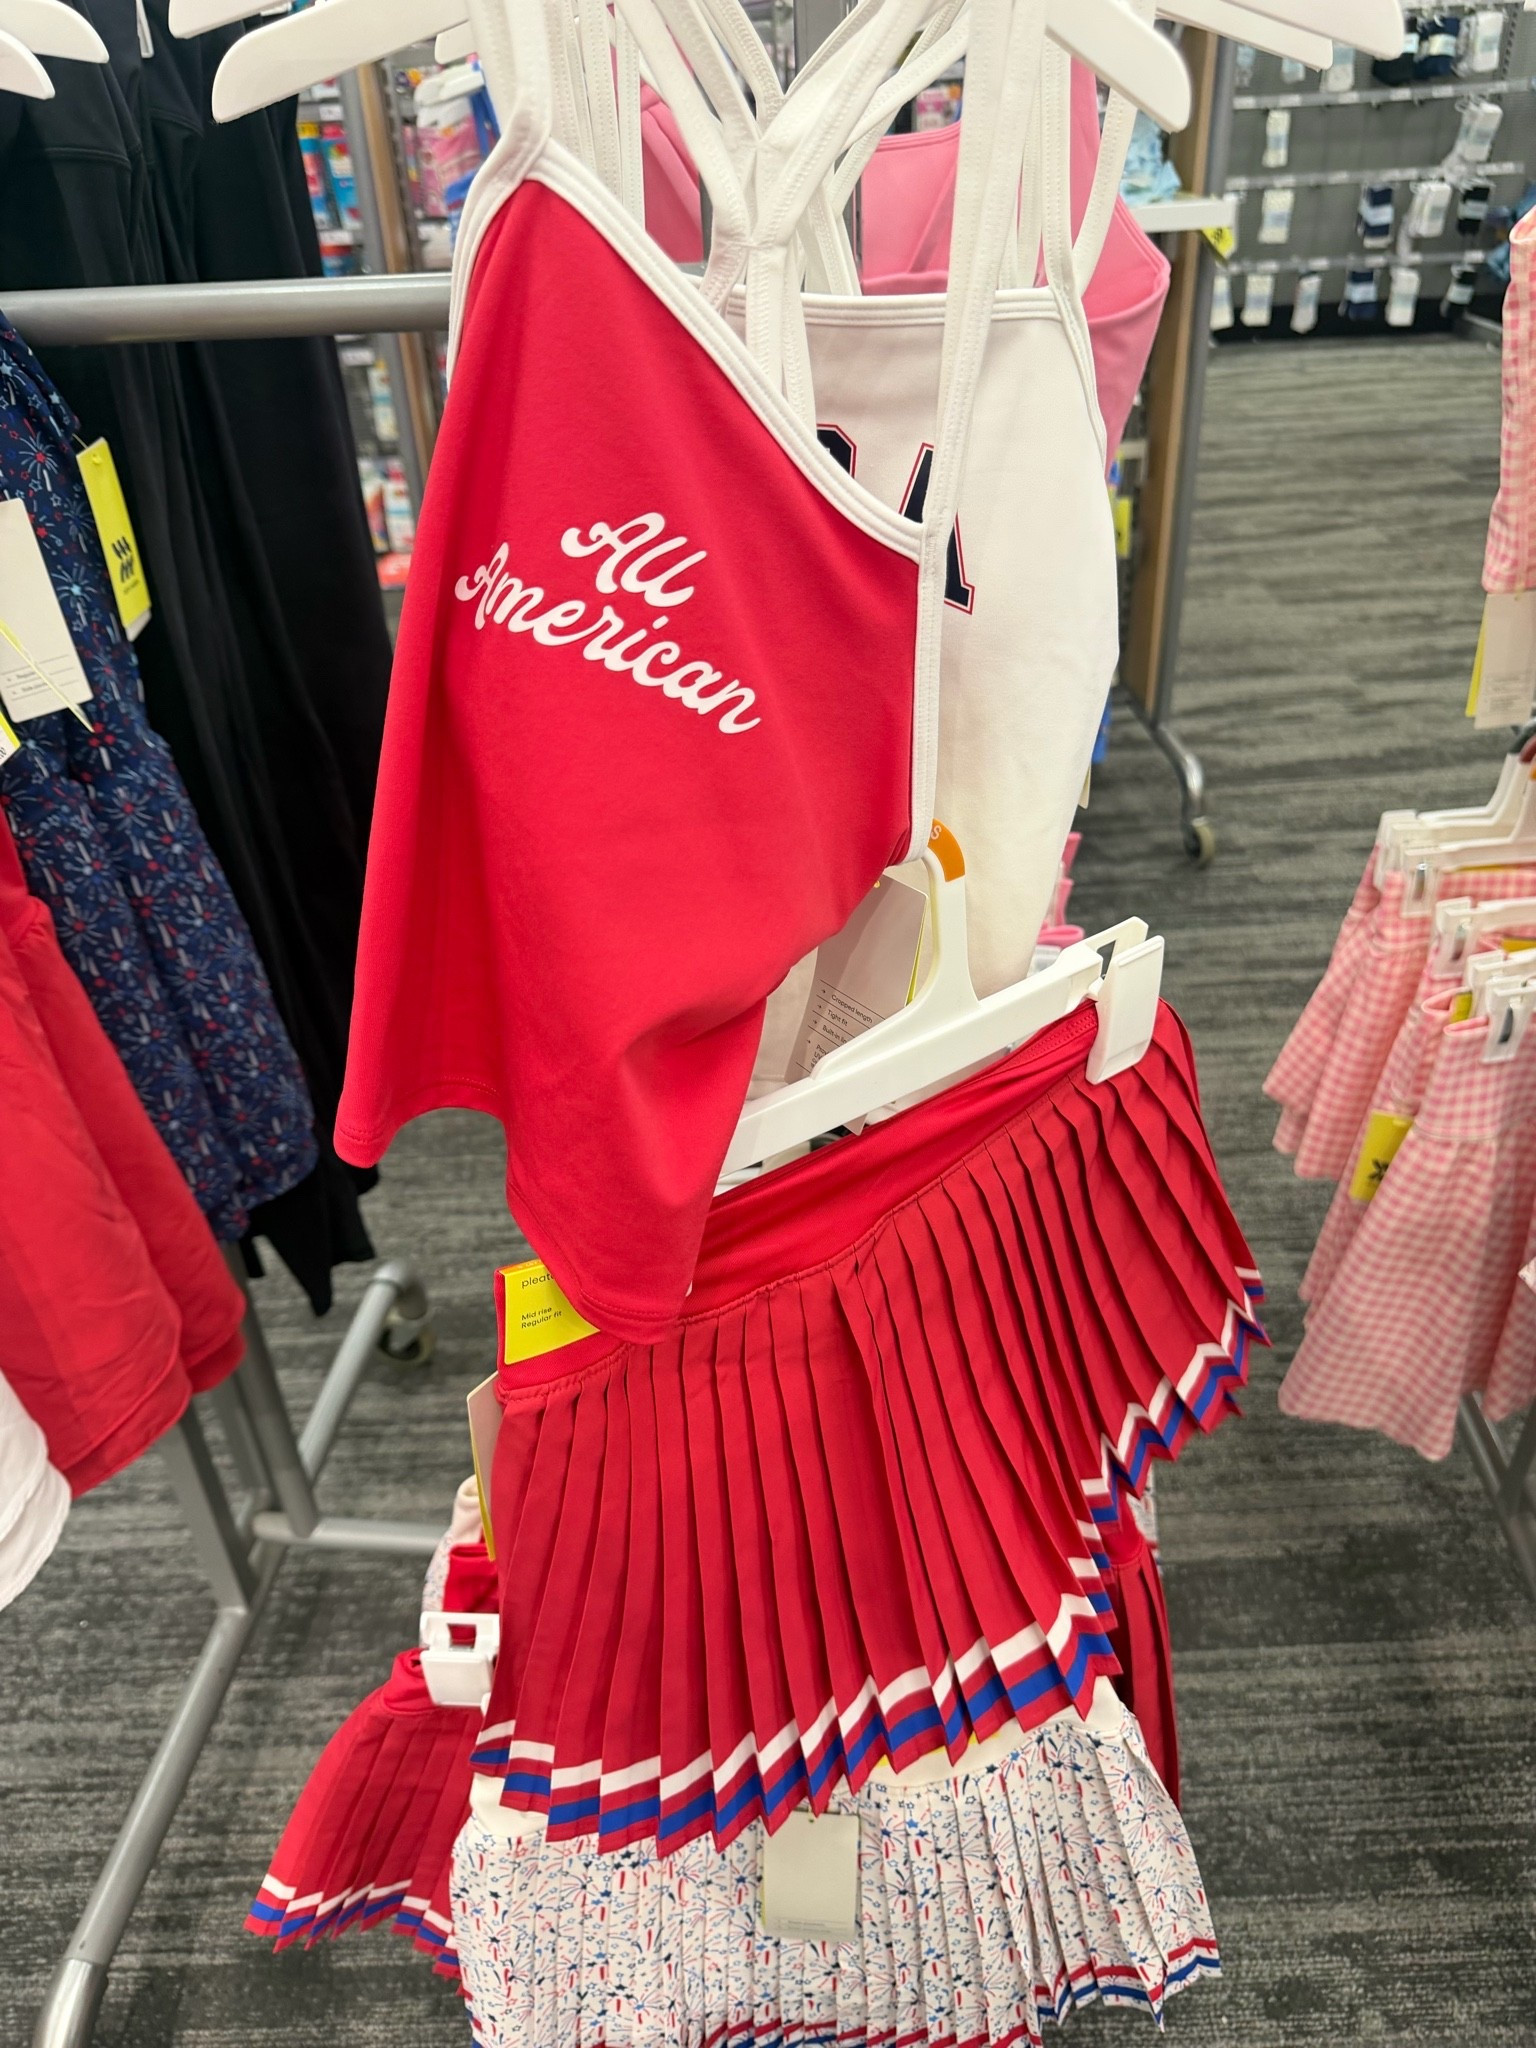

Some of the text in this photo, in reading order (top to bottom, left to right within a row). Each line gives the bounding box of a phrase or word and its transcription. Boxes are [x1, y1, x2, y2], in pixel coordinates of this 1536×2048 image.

[561, 512, 707, 607] All
[455, 542, 761, 734] American
[827, 1009, 841, 1022] Tight
[831, 994, 872, 1023] Cropped length
[822, 1025, 840, 1038] Built-in
[521, 1307, 552, 1321] Mid rise
[521, 1310, 562, 1329] Regular fit
